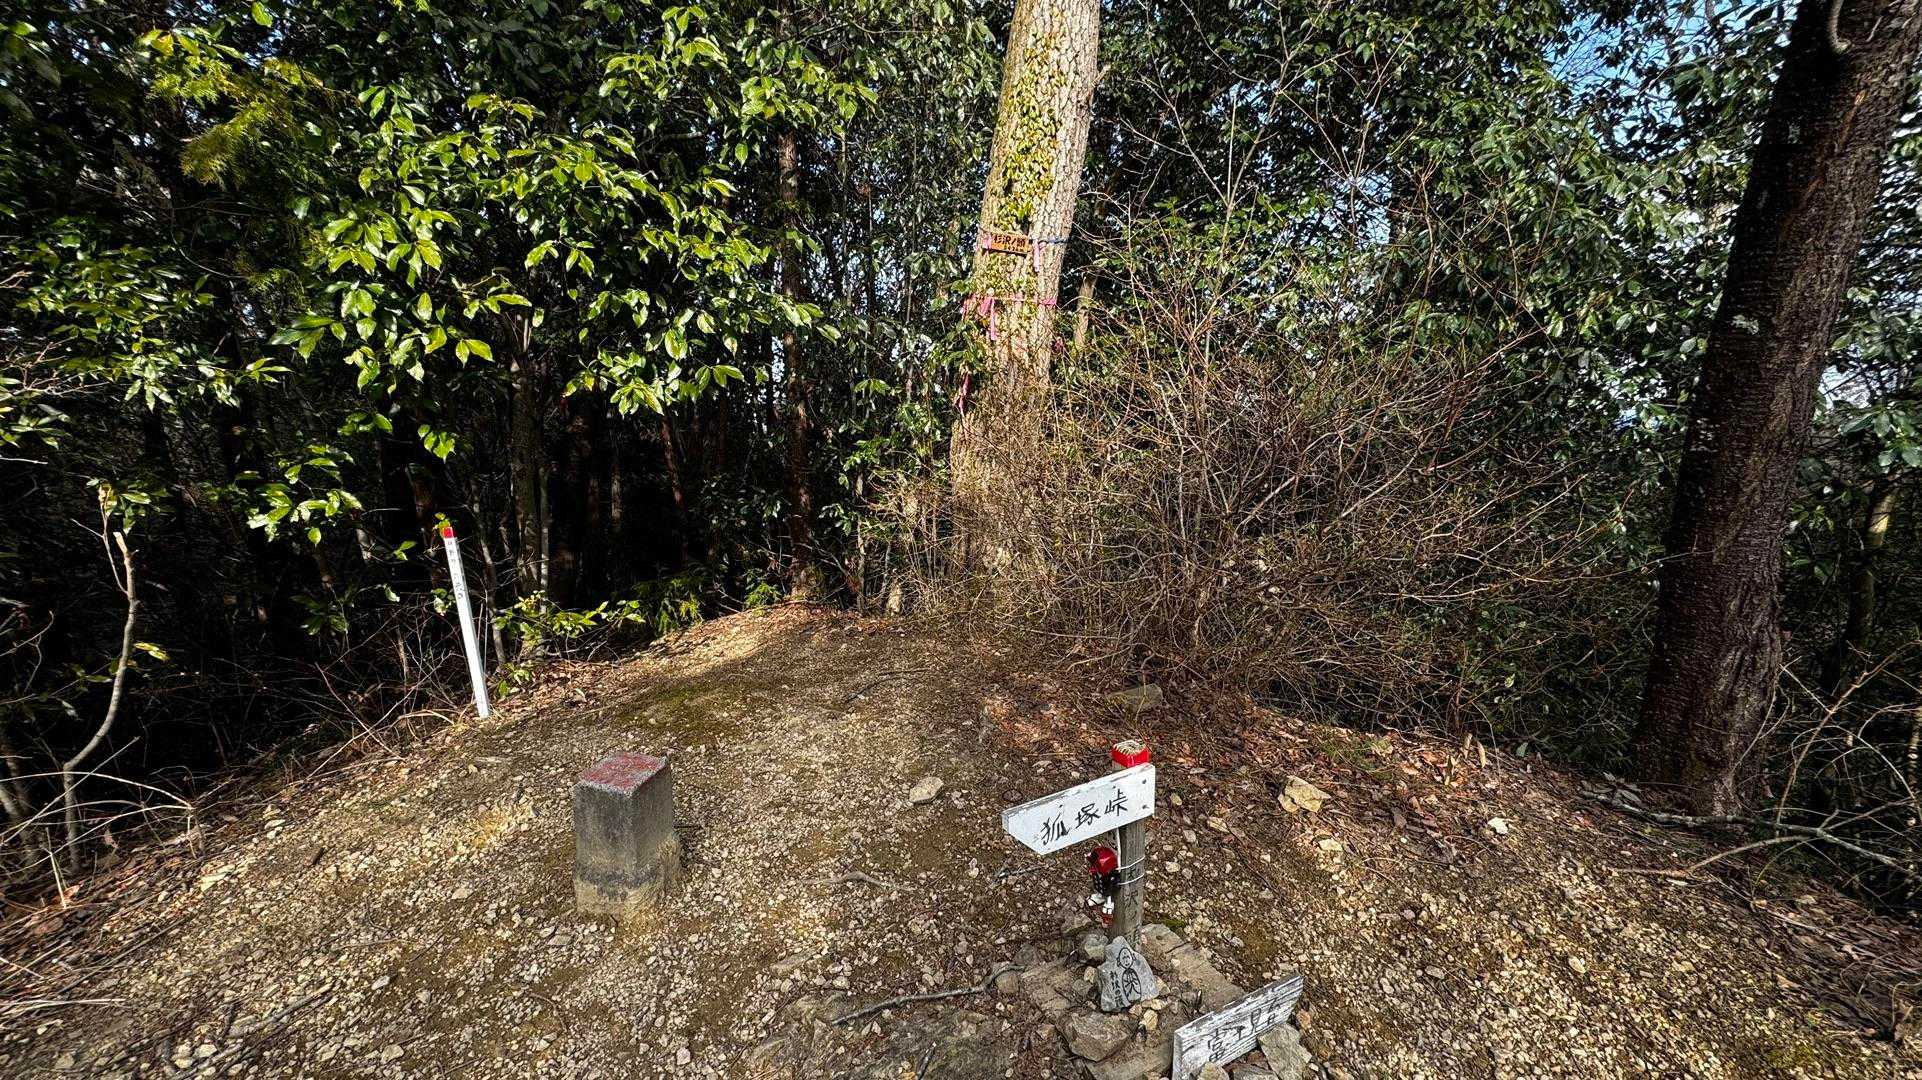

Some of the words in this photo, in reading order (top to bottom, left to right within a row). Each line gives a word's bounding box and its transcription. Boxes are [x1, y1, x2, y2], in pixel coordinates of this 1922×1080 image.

[1040, 789, 1128, 846] 狐塚峠
[1207, 998, 1280, 1062] 富士見台
